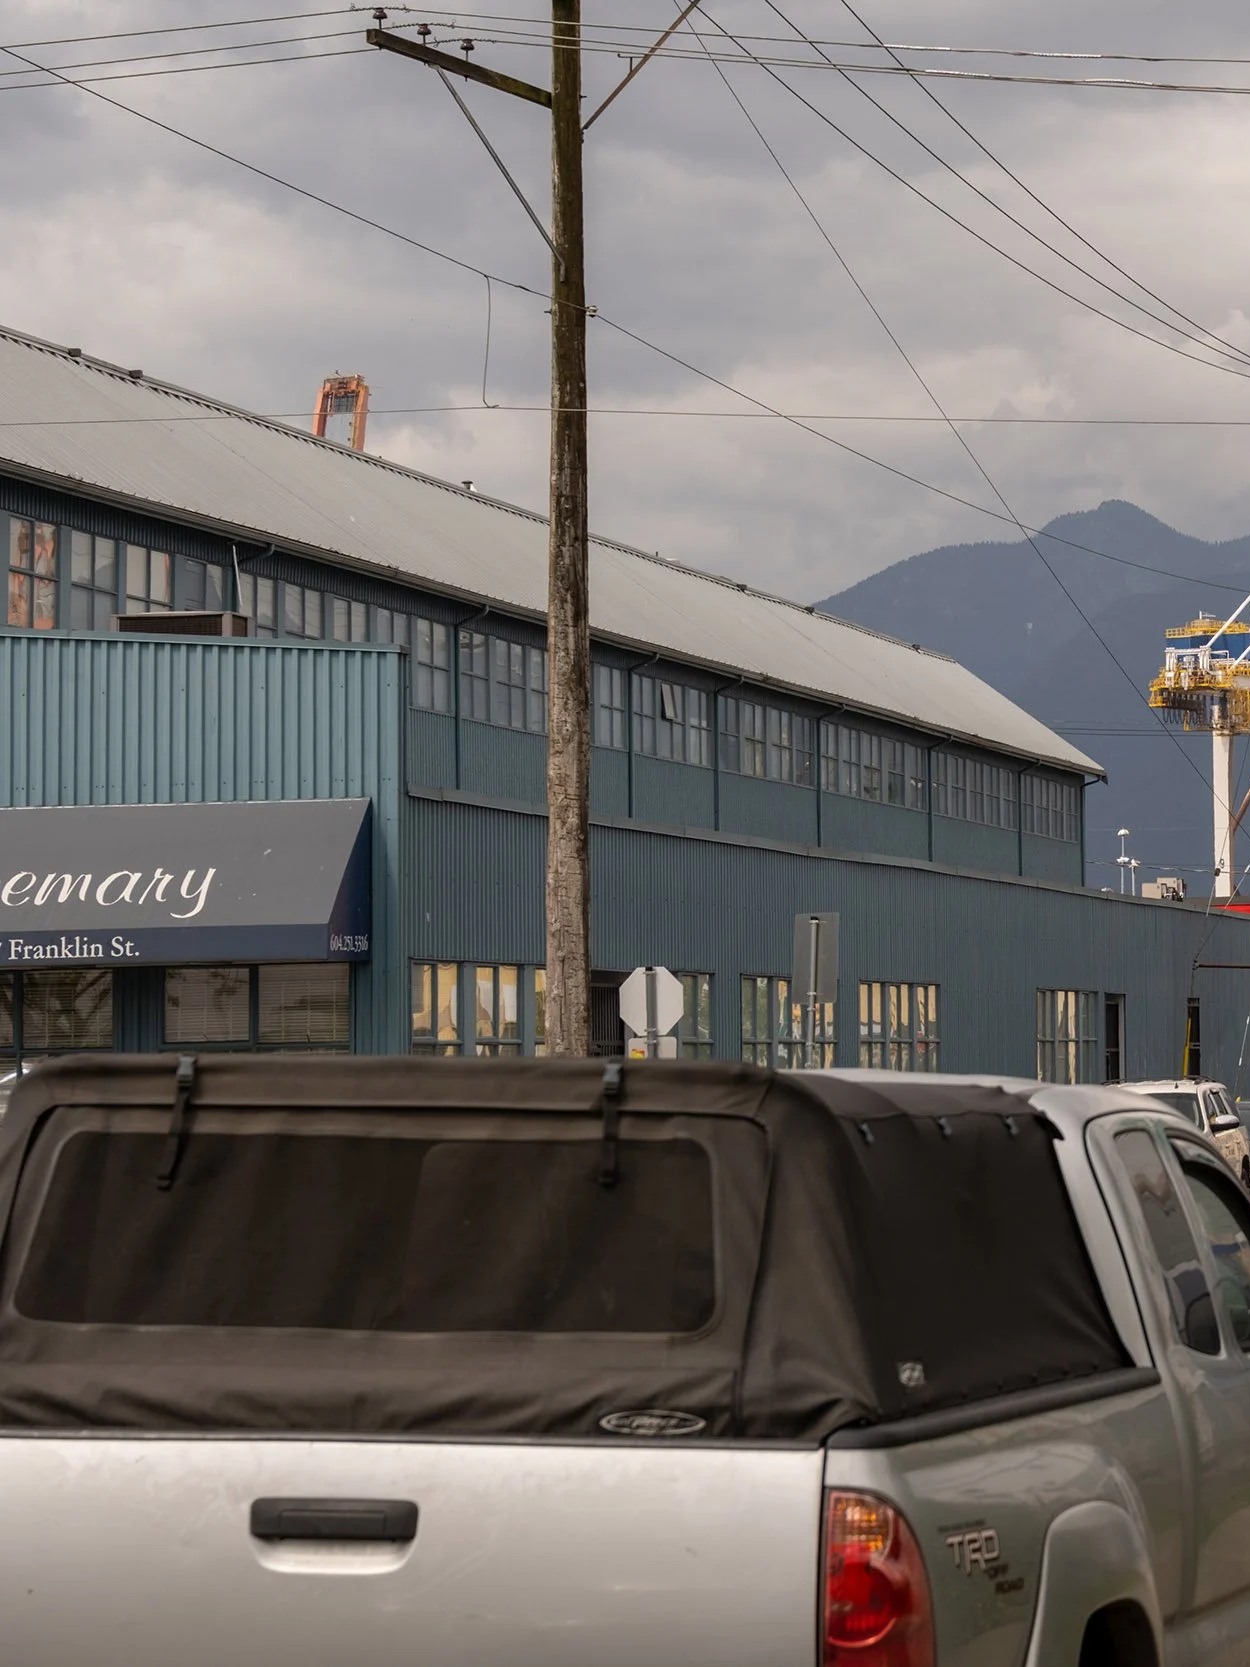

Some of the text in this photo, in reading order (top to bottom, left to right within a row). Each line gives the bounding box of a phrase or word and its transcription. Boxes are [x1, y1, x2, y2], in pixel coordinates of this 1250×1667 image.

[0, 867, 217, 919] emary
[8, 936, 140, 960] Franklin St.
[944, 1528, 999, 1577] TRD
